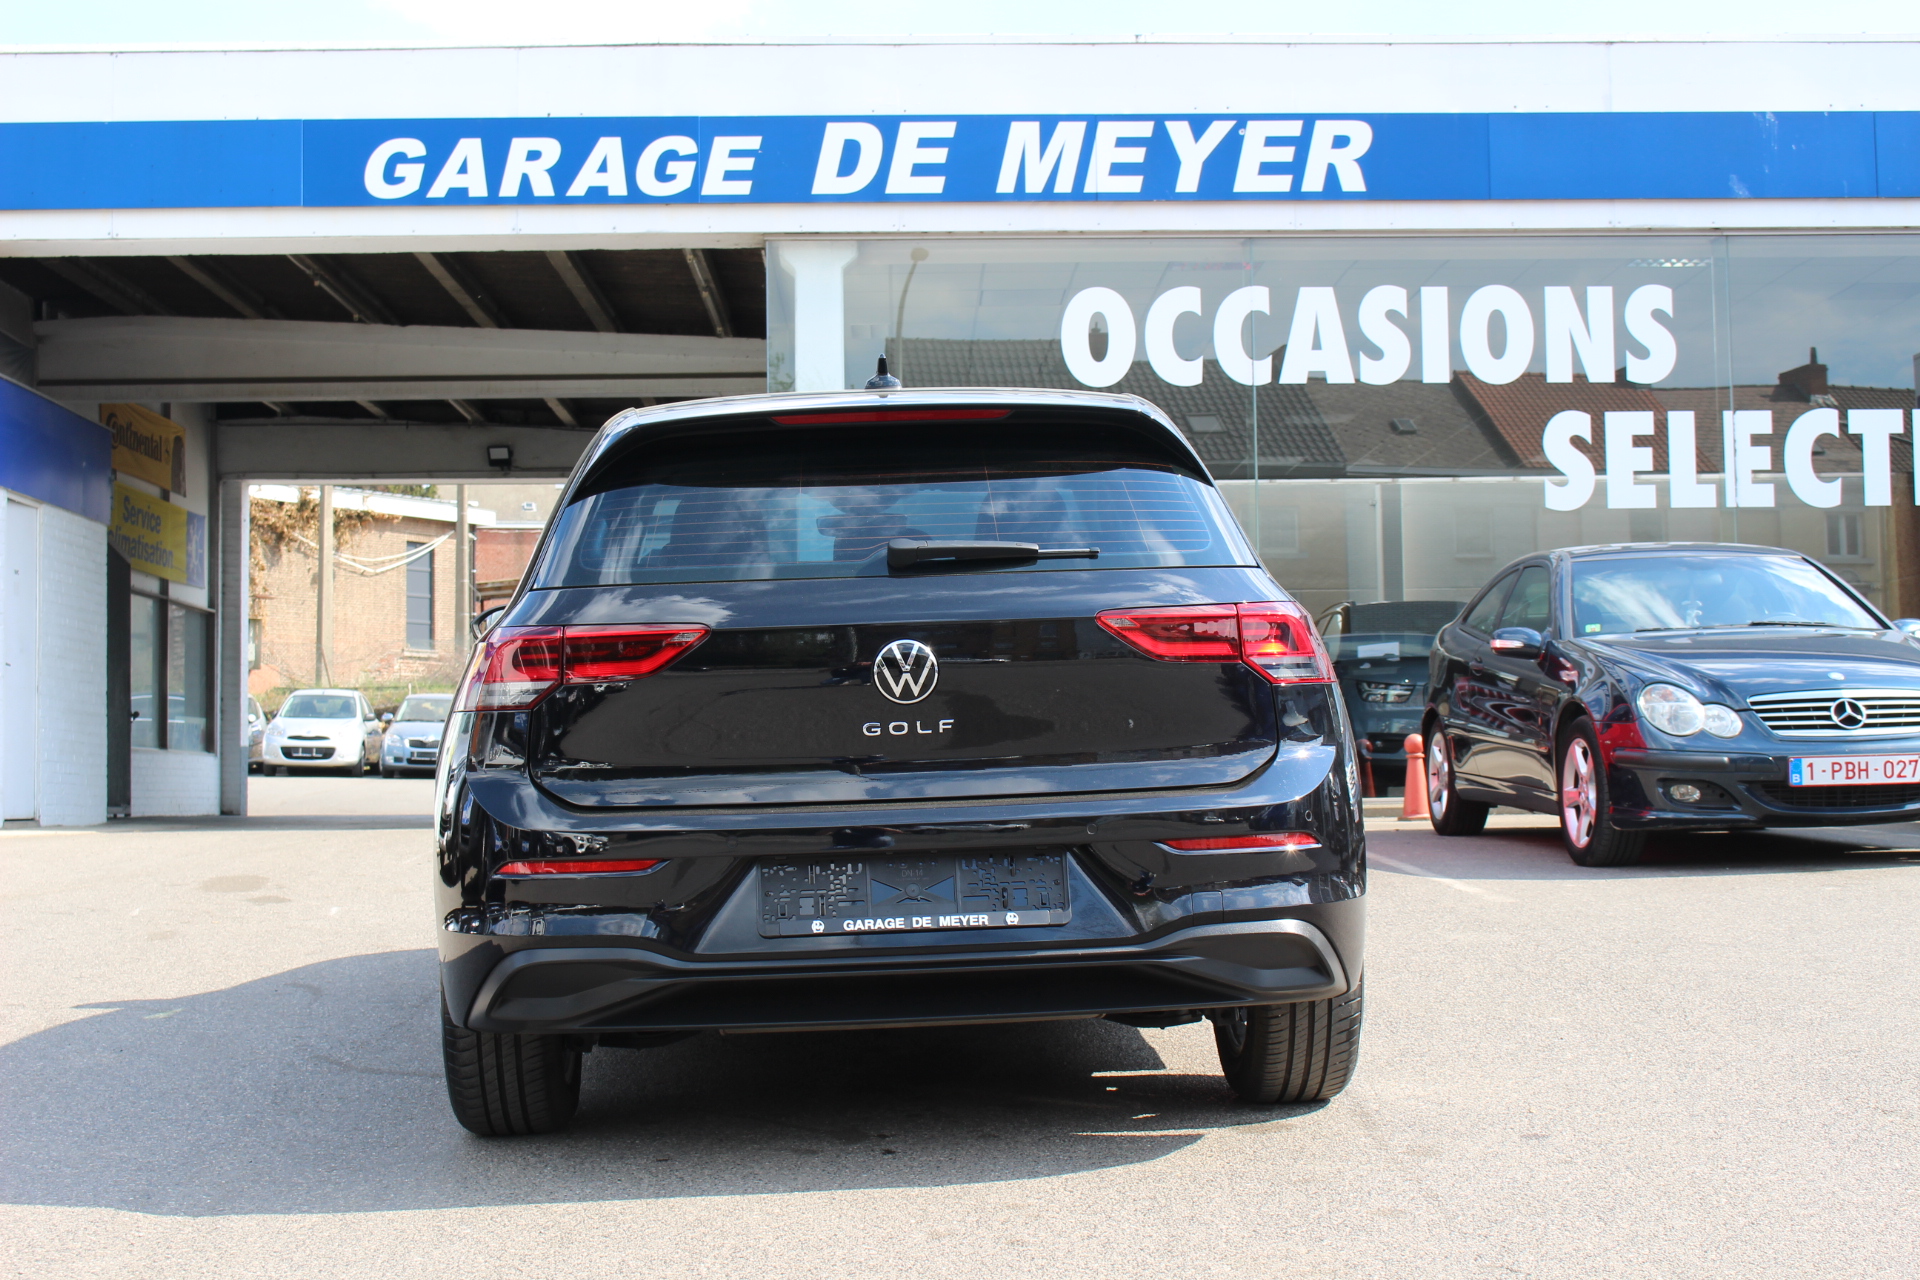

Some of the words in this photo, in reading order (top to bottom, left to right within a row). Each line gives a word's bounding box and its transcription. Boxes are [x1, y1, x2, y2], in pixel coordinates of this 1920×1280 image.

[362, 135, 762, 200] GARAGE
[811, 121, 957, 196] DE
[996, 119, 1374, 195] MEYER
[1061, 285, 1676, 387] OCCASIONS
[1542, 409, 1920, 510] SELECT
[122, 495, 162, 534] Service
[862, 719, 955, 737] GOLF
[1792, 773, 1801, 784] B
[1806, 759, 1919, 781] 1-PBH-027
[843, 917, 905, 932] GARAGE
[912, 916, 932, 929] DE
[939, 914, 989, 928] MEYER
